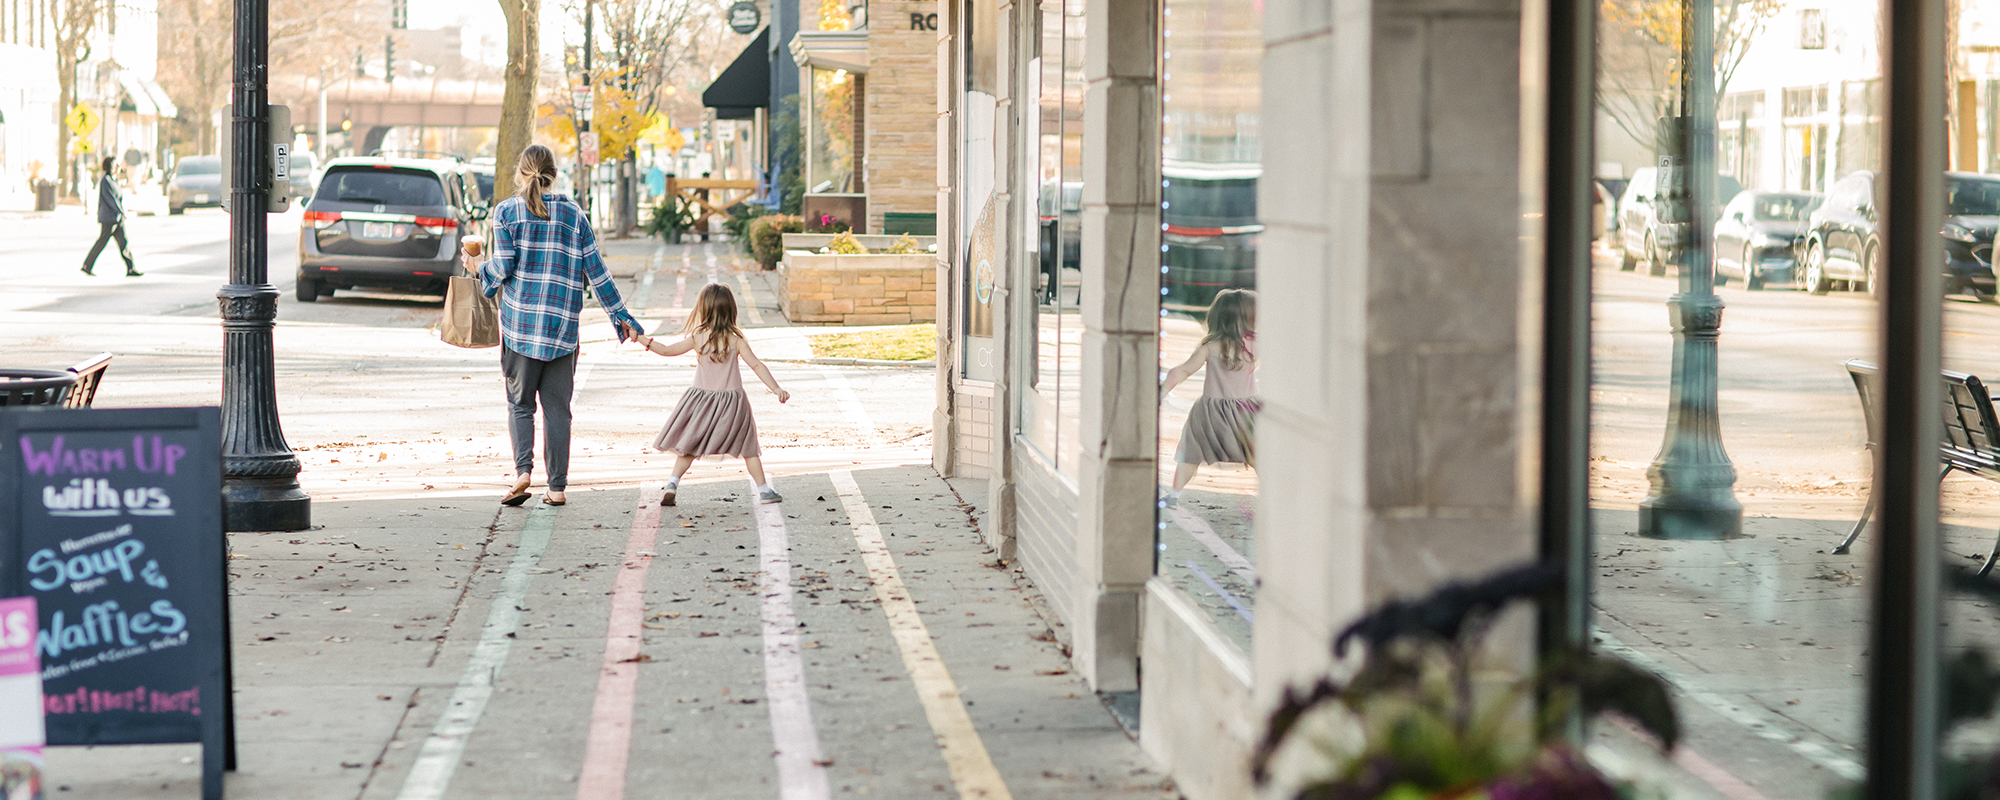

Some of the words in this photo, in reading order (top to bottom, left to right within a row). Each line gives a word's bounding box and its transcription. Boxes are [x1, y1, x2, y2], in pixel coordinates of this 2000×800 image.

[42, 477, 121, 510] with
[123, 486, 172, 510] us
[26, 538, 145, 592] Soup
